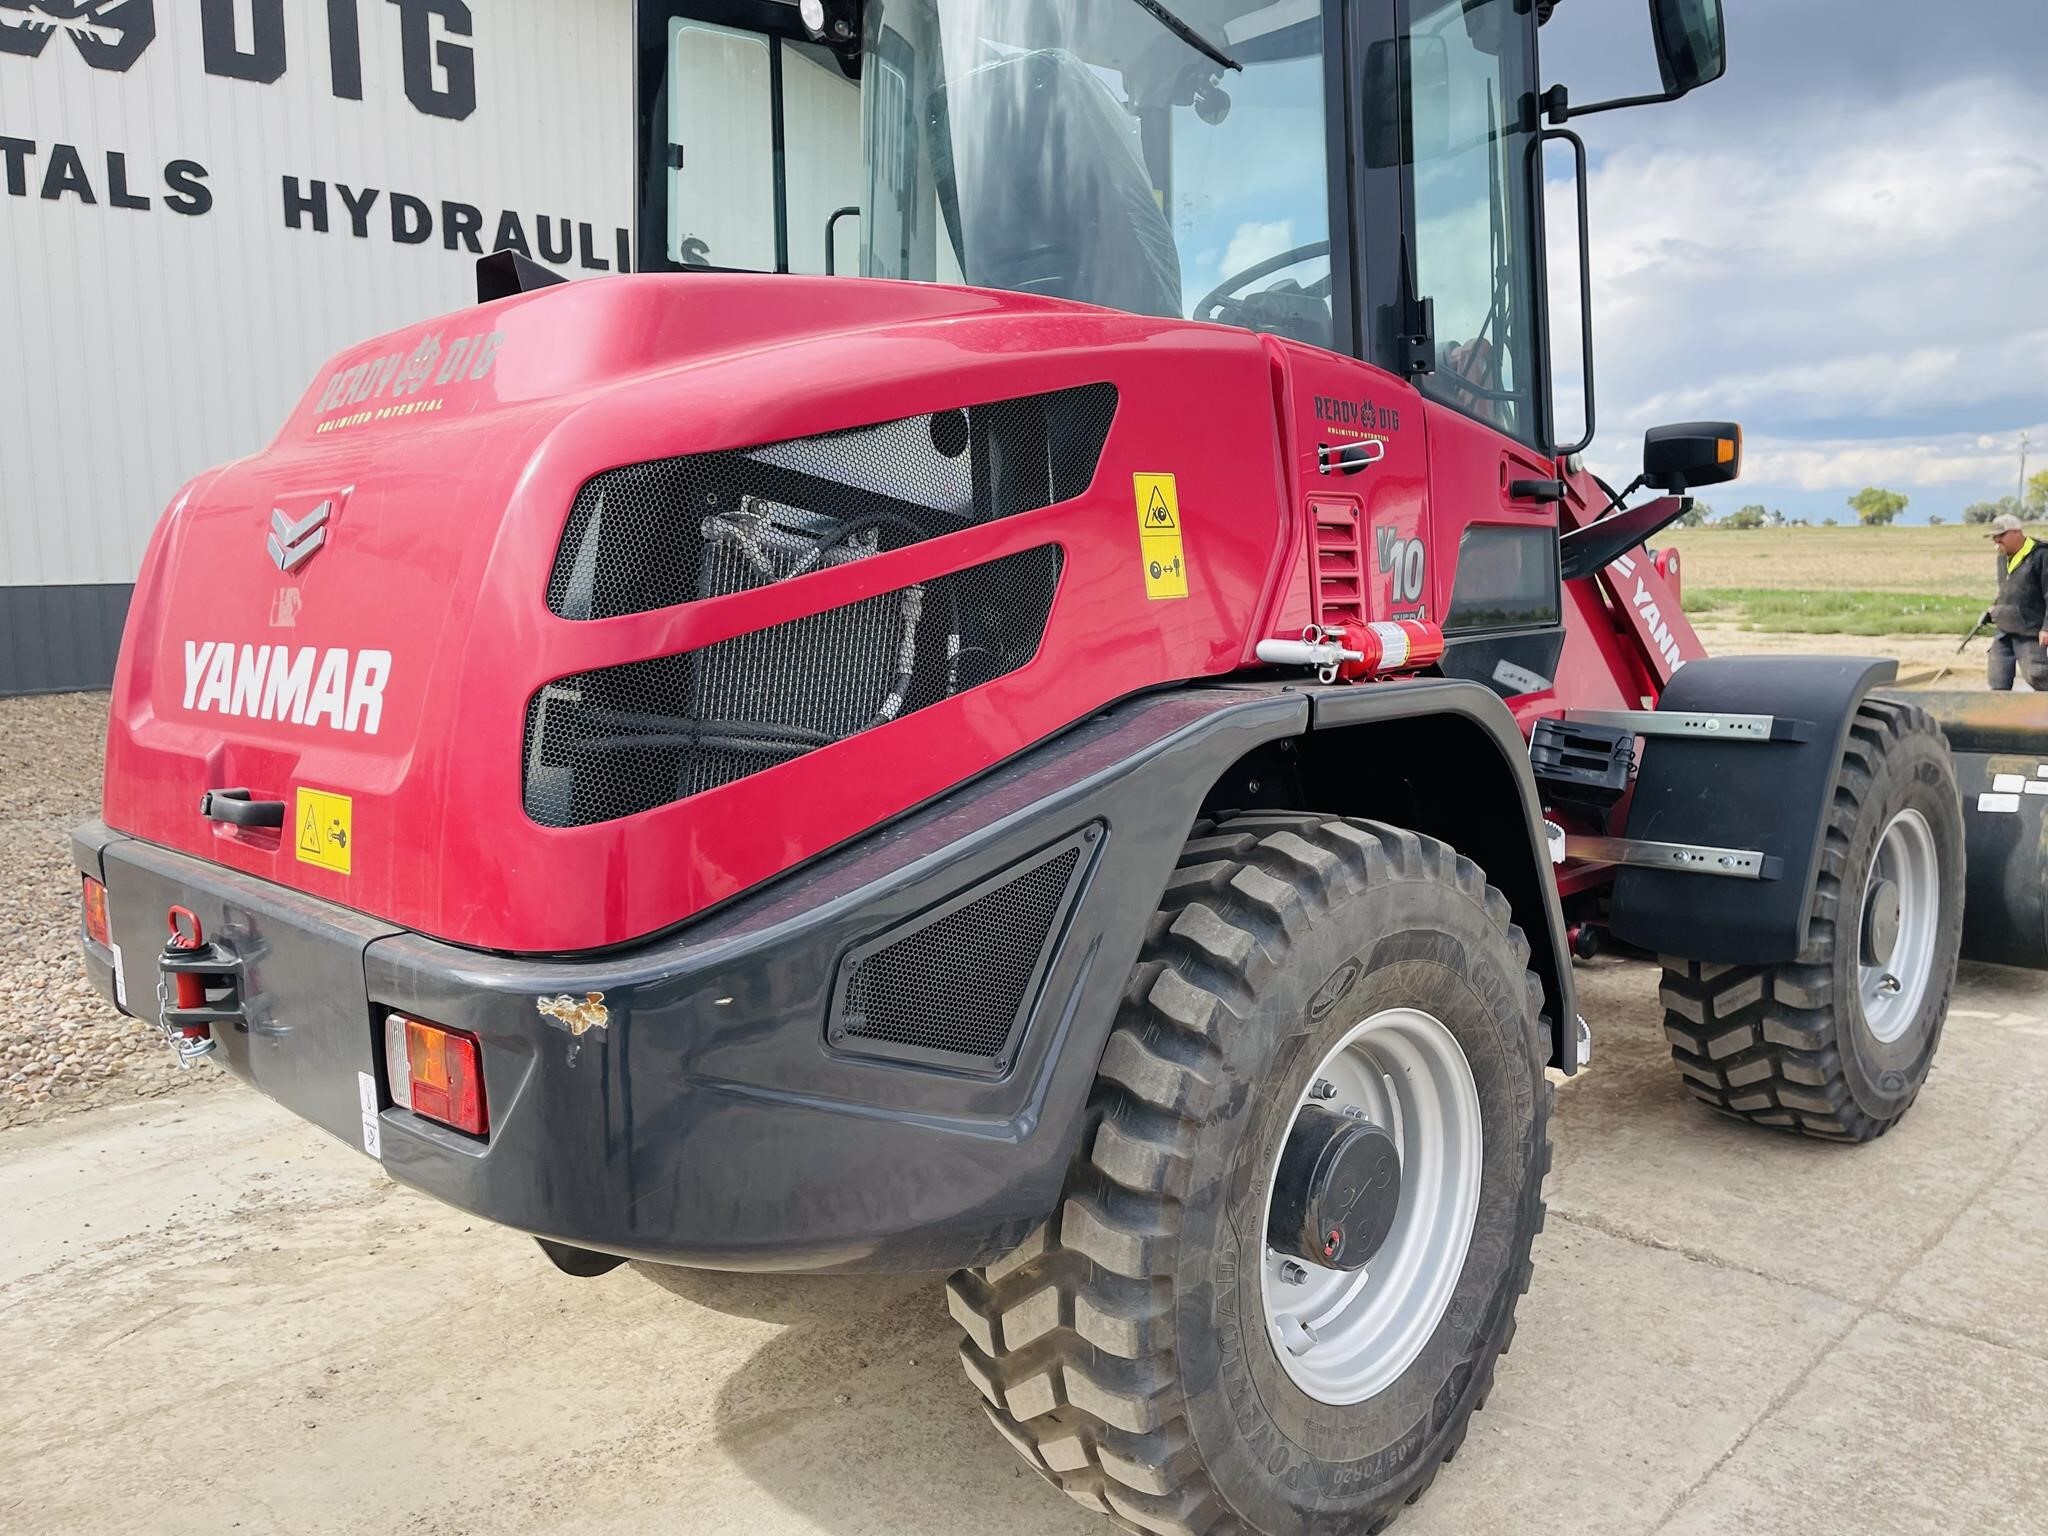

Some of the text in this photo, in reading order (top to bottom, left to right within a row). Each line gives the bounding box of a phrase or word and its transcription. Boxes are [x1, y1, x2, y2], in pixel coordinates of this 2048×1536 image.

[282, 175, 710, 273] HYDRAULIS
[315, 331, 504, 413] READY DIG
[316, 398, 444, 434] UNLIMITED POTENTIAL
[1314, 395, 1400, 431] READY DIG
[1327, 426, 1390, 442] UNLIMITED POTENTIAL
[1375, 525, 1426, 604] V10
[183, 640, 392, 735] YANMAR
